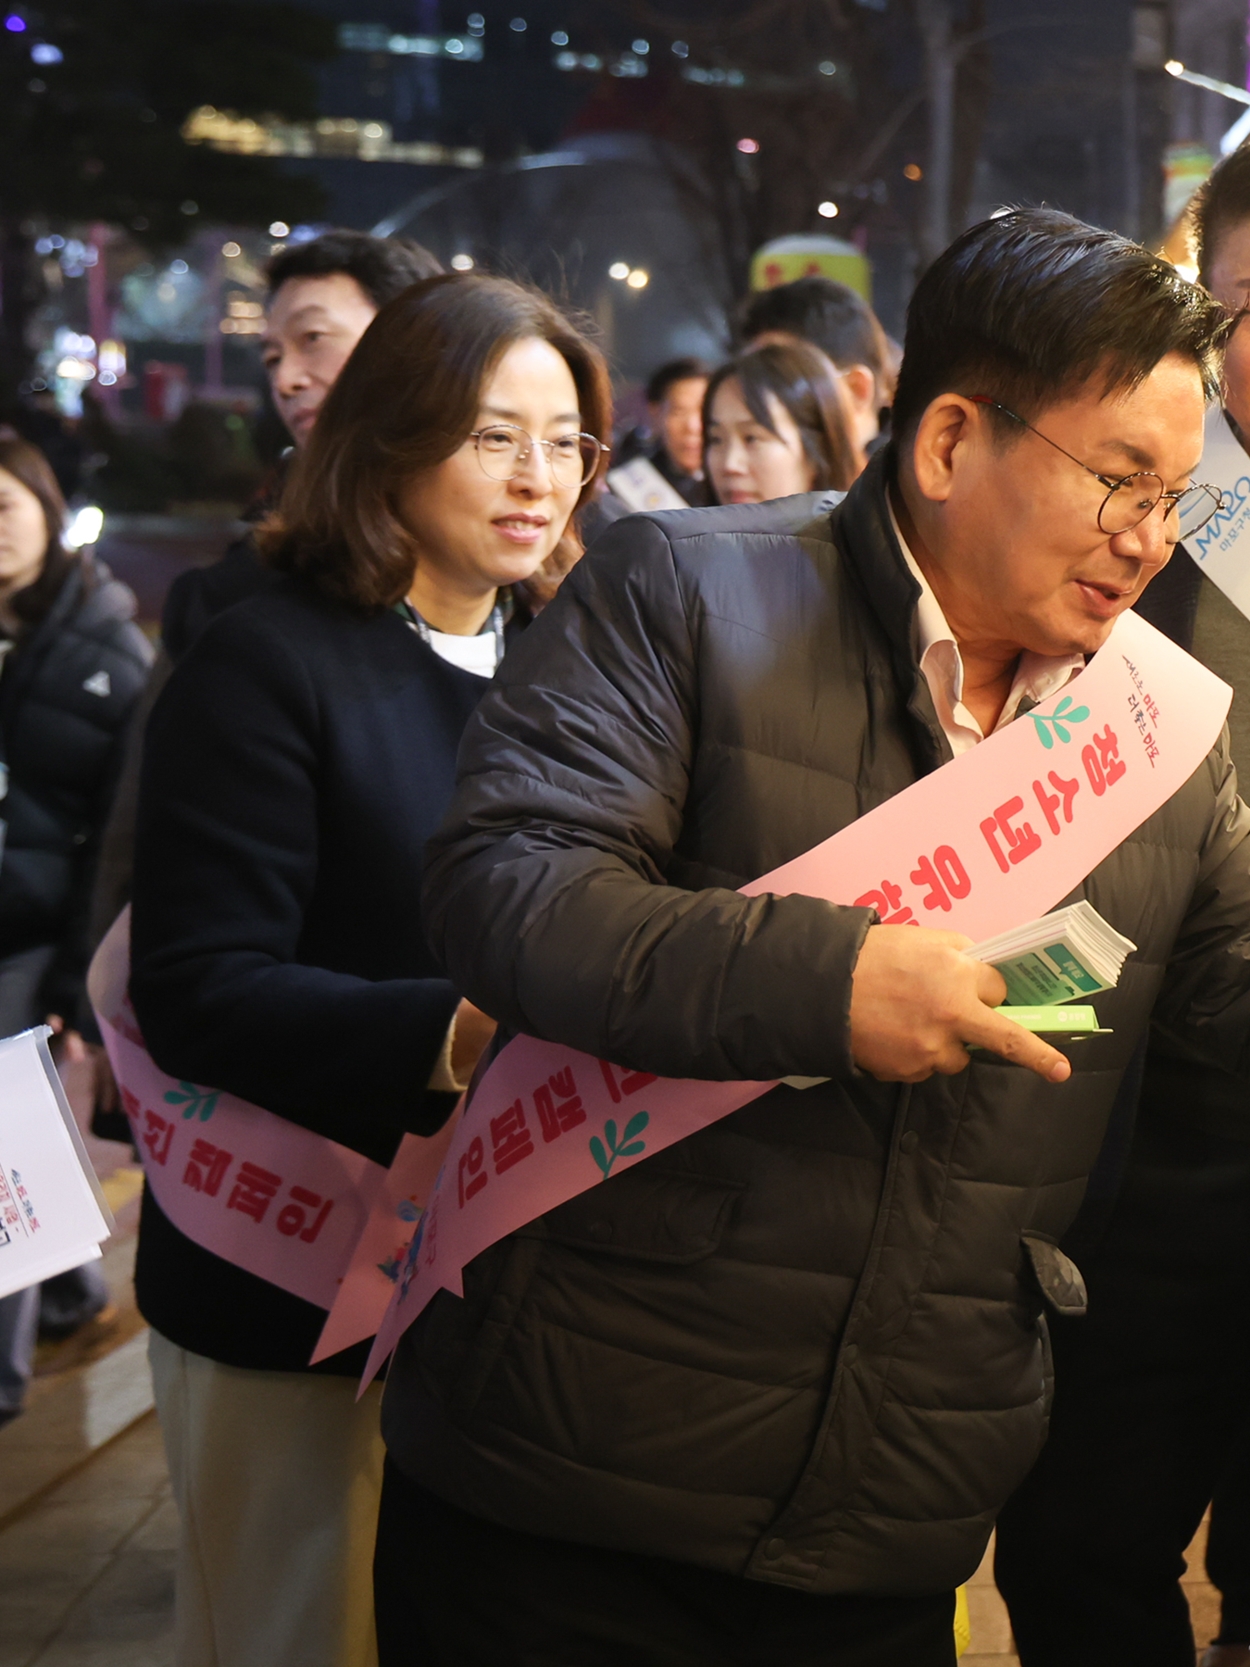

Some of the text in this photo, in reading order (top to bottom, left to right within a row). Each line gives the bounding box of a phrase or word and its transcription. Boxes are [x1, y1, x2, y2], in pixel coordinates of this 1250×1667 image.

[1122, 655, 1160, 728] 새로운 마포
[1127, 694, 1160, 768] 더 좋은 마포
[979, 723, 1126, 874] 청소년
[182, 1137, 335, 1244] 캠페인
[457, 1065, 587, 1209] 캠페인
